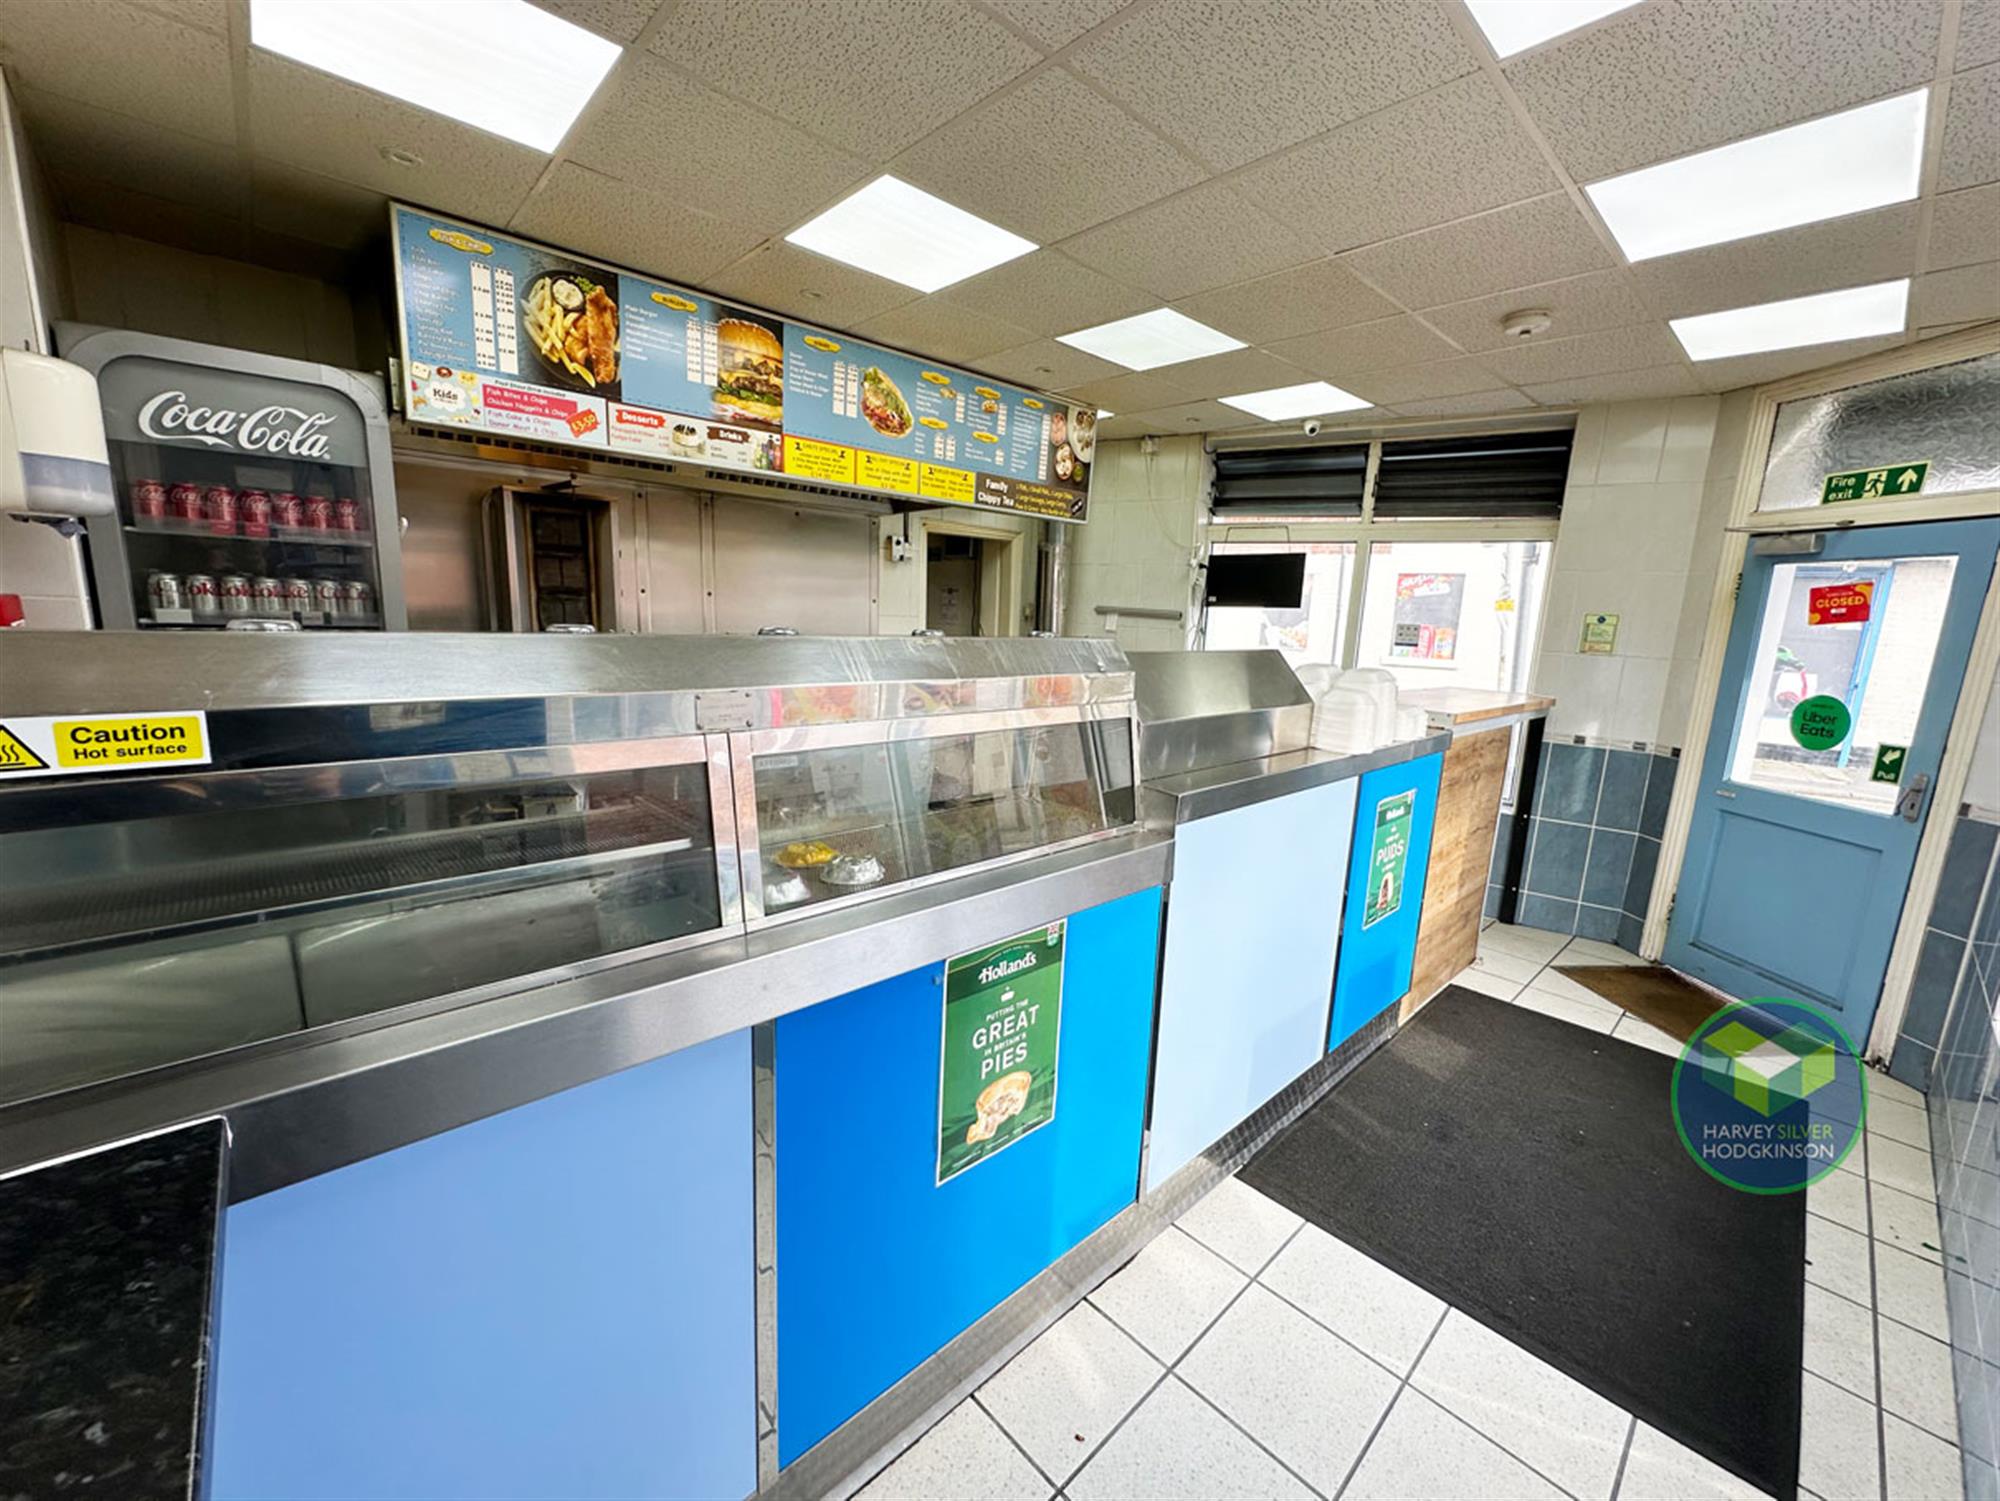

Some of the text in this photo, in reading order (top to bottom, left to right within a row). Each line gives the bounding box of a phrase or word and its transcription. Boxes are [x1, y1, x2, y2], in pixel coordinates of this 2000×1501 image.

[433, 388, 458, 401] Kids
[487, 388, 501, 397] Fish
[530, 395, 548, 405] Chips
[487, 397, 514, 408] Chicken
[138, 390, 338, 459] Coca-Cola
[571, 414, 596, 432] £3.50
[622, 411, 659, 426] Desserts
[719, 429, 743, 442] Drinks
[986, 478, 1008, 493] Family
[1831, 477, 1857, 488] Fire
[978, 491, 1014, 507] Chippy Tea
[1828, 488, 1853, 501] exit
[1816, 596, 1864, 609] CLOSED
[1803, 710, 1838, 725] Uber
[70, 724, 185, 745] Caution
[1799, 723, 1835, 738] Eats
[73, 744, 187, 760] Hot surface
[1877, 770, 1896, 780] Pull
[1376, 839, 1405, 866] PUDS
[986, 998, 1029, 1022] PUTTING THE
[972, 1004, 1040, 1050] GREAT
[984, 1032, 1027, 1056] IN BRITAIN'S
[981, 1042, 1028, 1080] PIES
